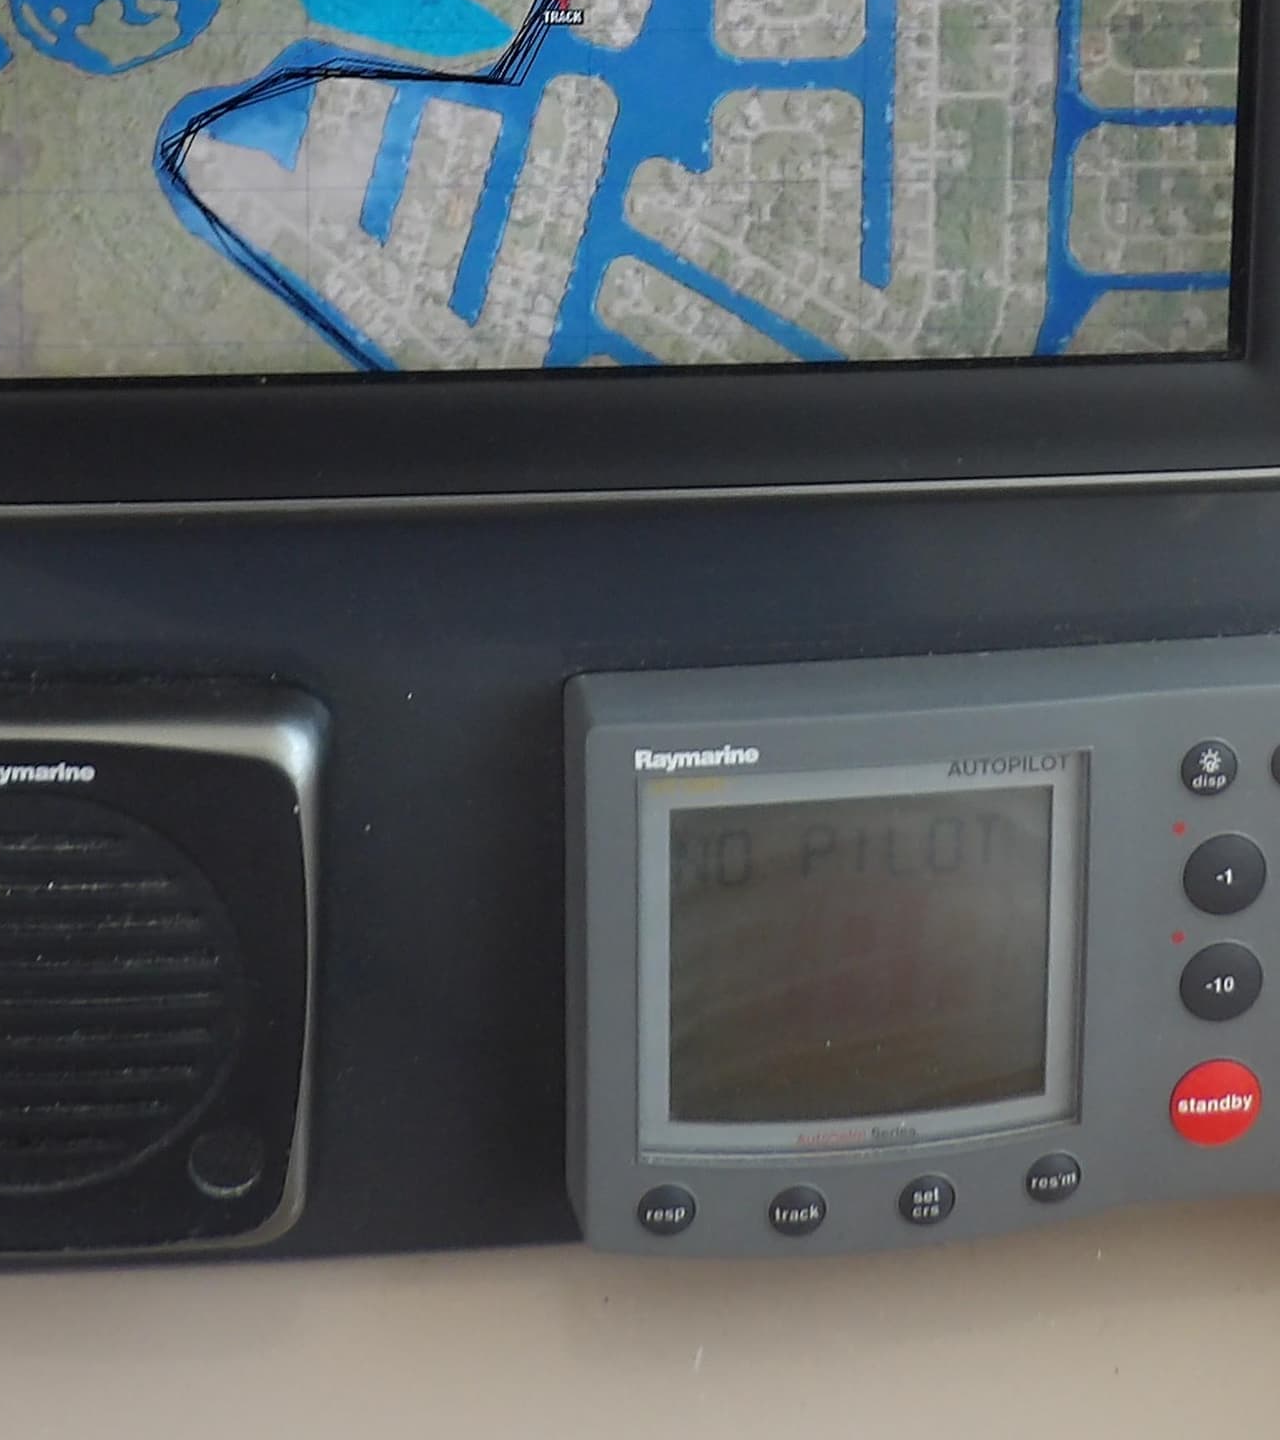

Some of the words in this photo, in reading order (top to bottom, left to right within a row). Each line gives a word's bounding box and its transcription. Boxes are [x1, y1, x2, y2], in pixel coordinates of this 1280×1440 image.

[543, 10, 584, 25] TRACK
[634, 744, 760, 773] Raymarine
[948, 753, 1070, 777] AUTOPILOT
[1191, 773, 1228, 789] disp
[1215, 867, 1234, 885] -1
[1205, 975, 1236, 993] -10
[1177, 1093, 1254, 1114] standby
[912, 1186, 941, 1205] set
[646, 1206, 687, 1224] resp
[774, 1202, 819, 1224] track
[912, 1204, 941, 1219] crs
